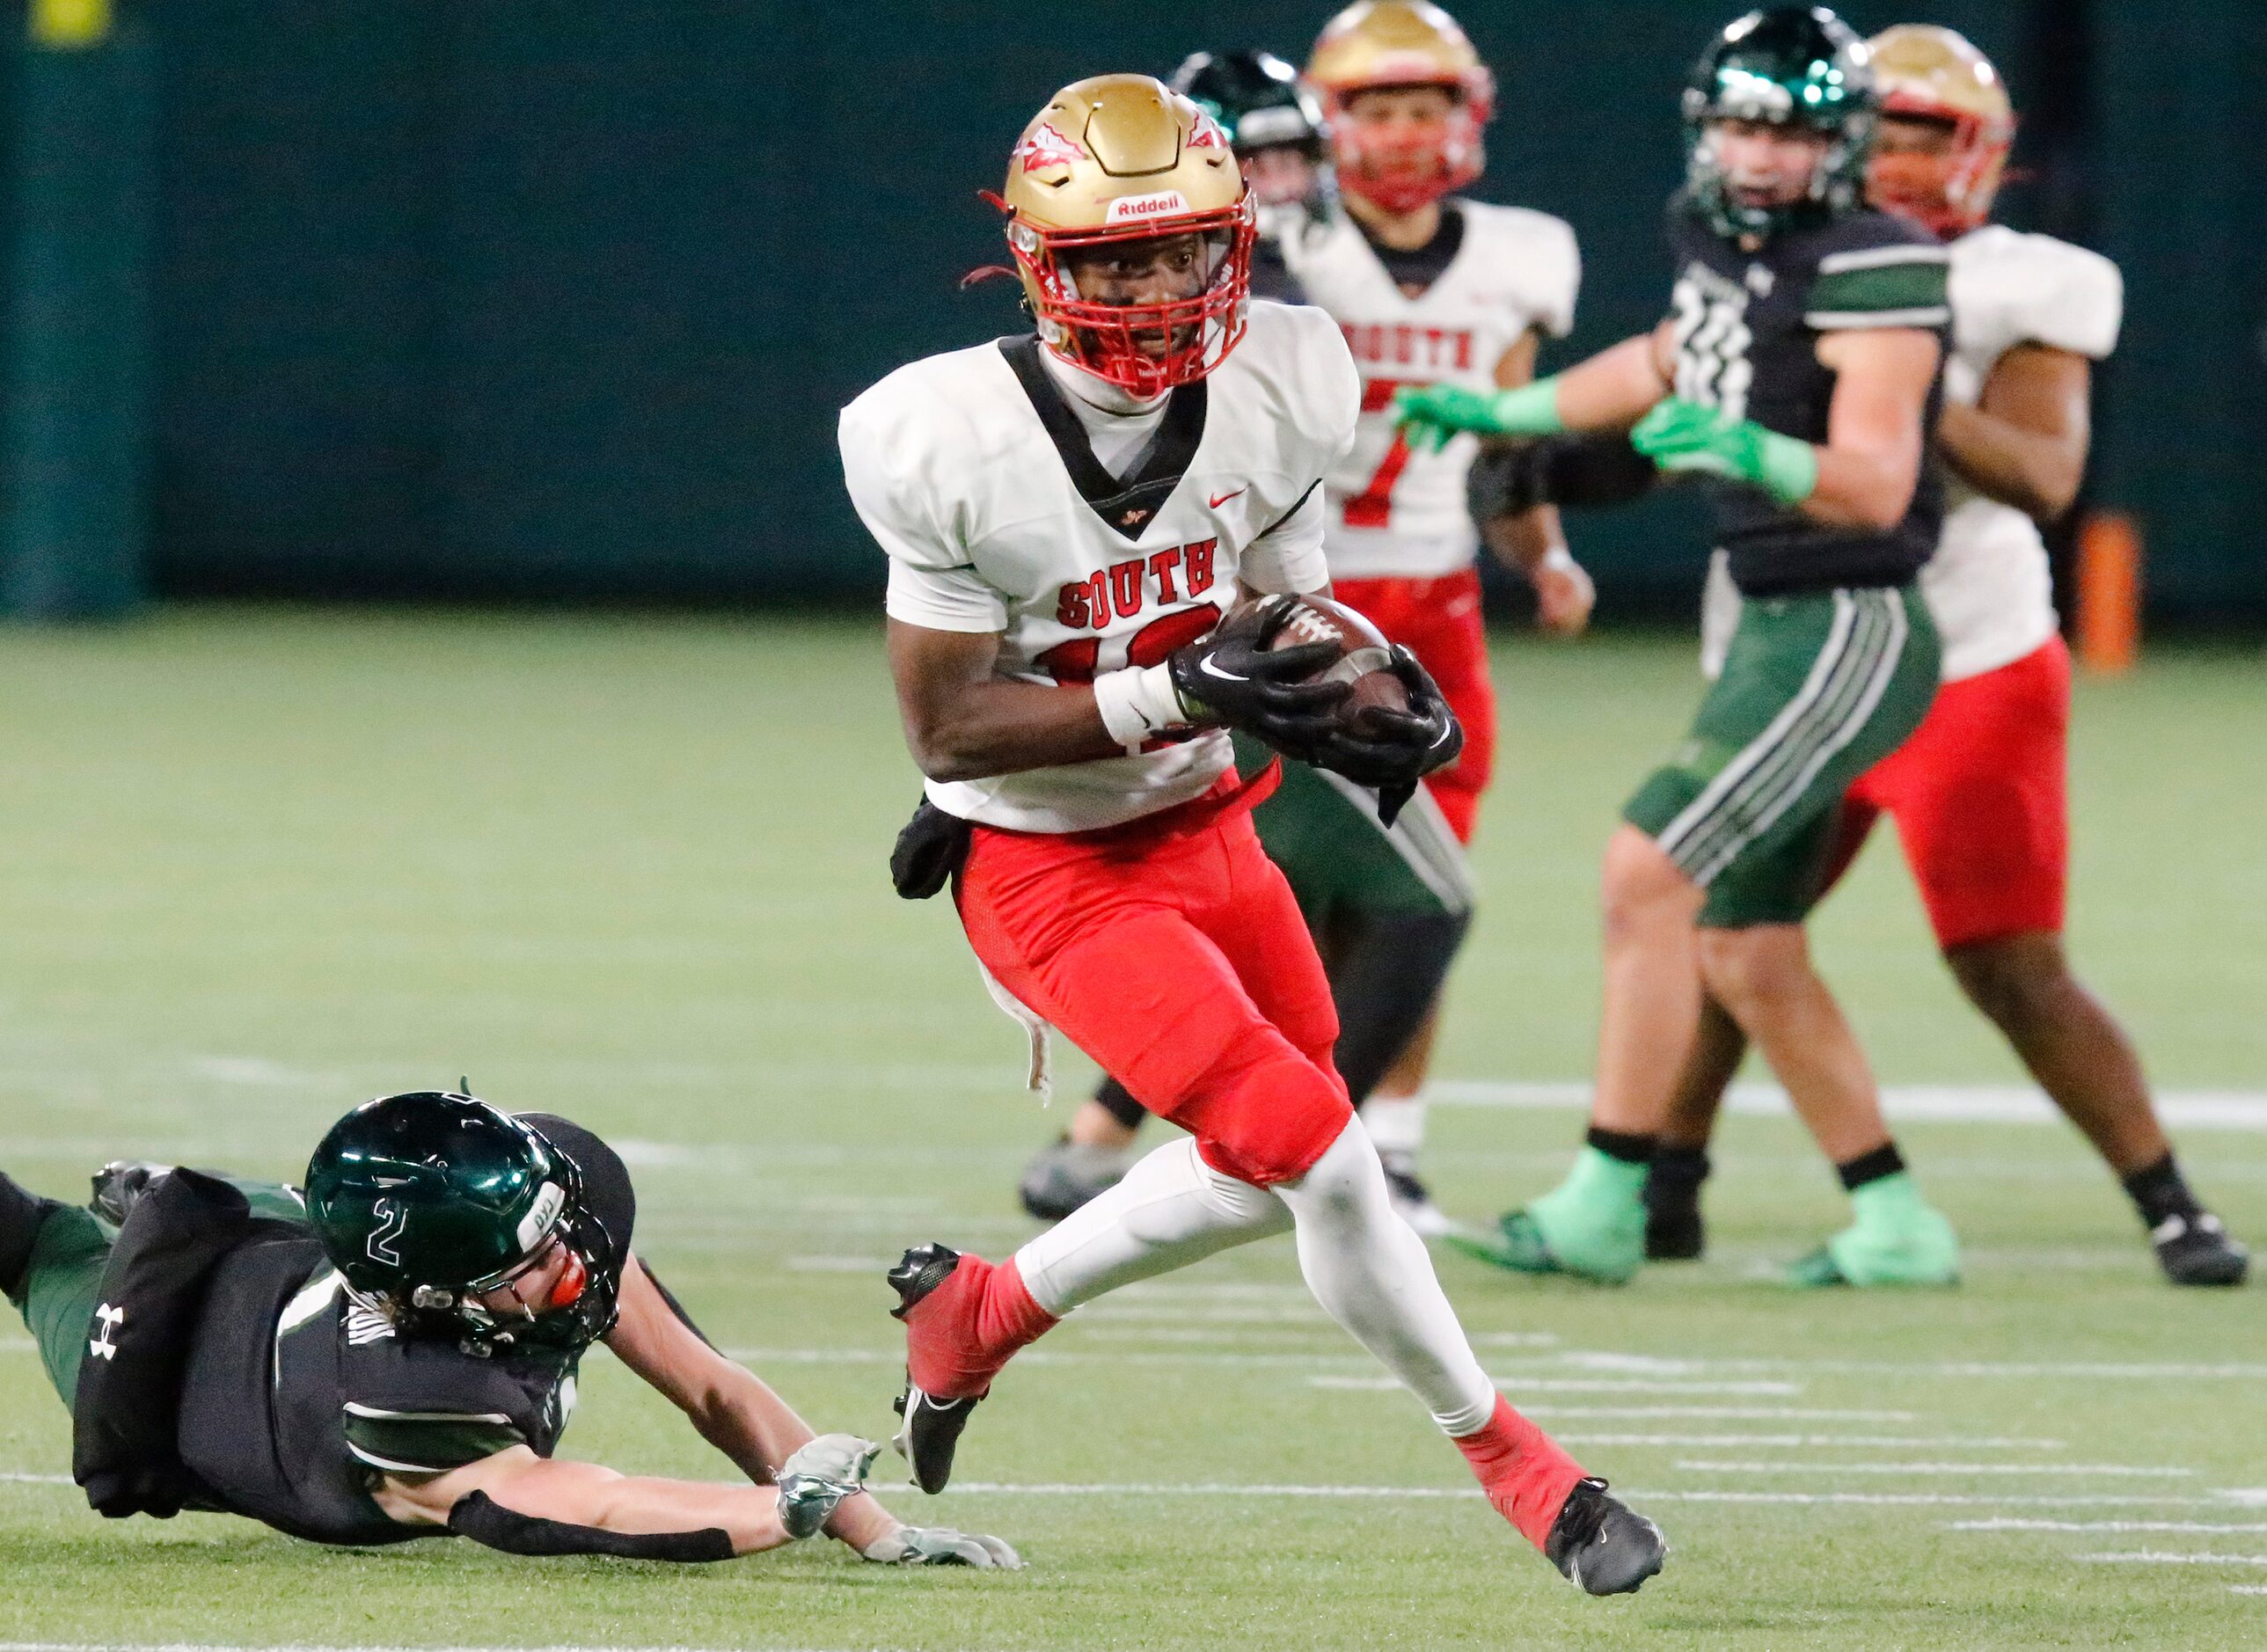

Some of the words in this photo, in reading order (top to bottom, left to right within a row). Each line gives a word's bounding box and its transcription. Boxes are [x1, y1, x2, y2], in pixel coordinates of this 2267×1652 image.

[1118, 194, 1179, 216] Riddell
[1056, 537, 1218, 630] SOUTH
[367, 1197, 409, 1268] 2
